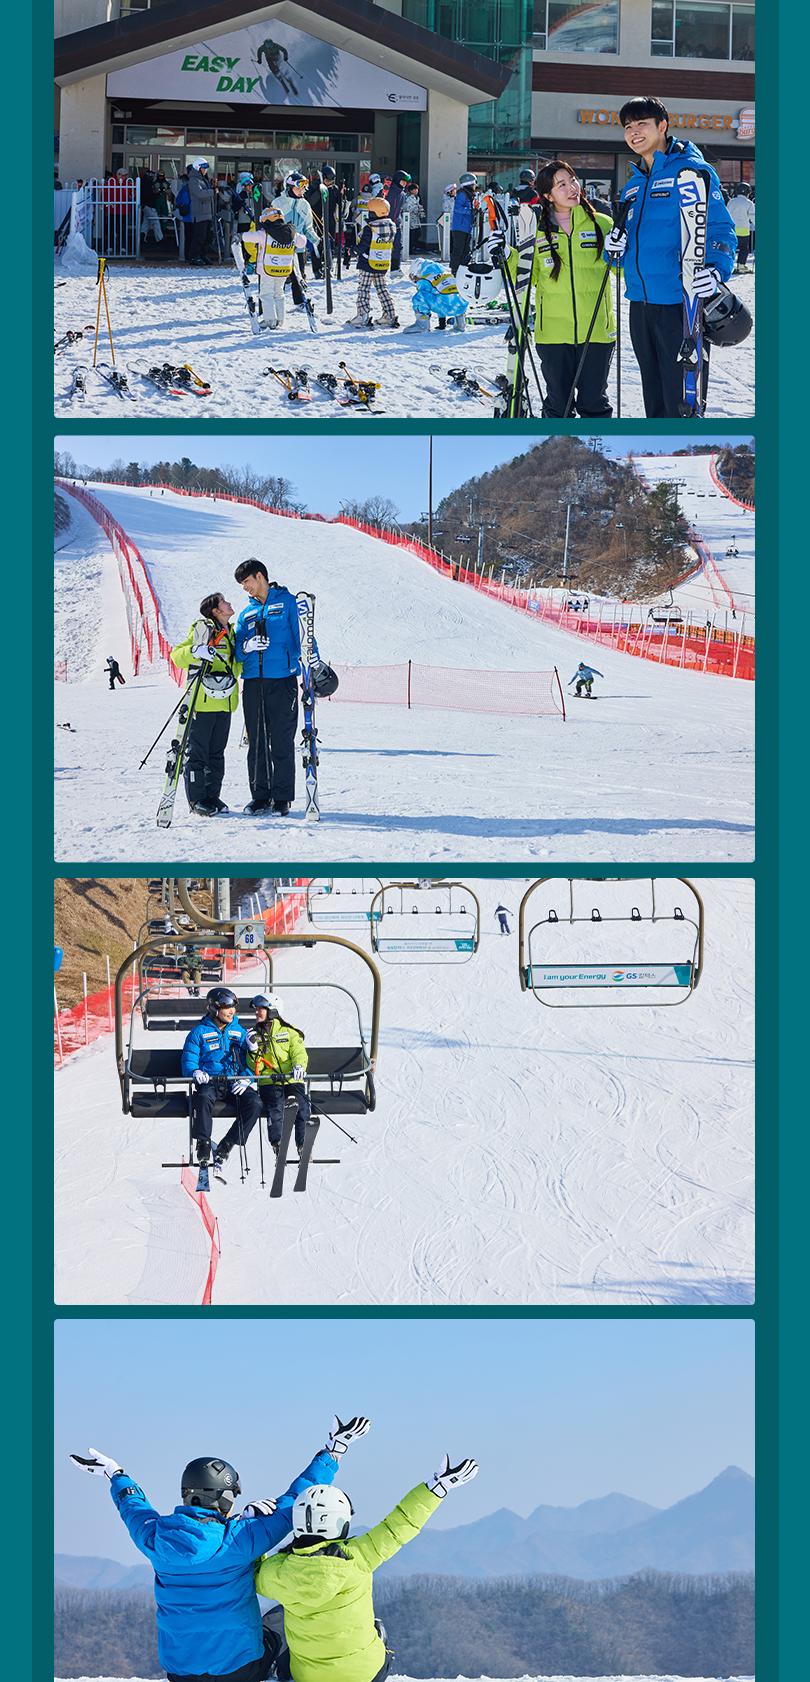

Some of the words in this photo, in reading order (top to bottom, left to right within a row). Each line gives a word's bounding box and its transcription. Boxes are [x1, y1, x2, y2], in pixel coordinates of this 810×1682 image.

[181, 55, 240, 72] EASY
[216, 75, 260, 93] DAY
[578, 109, 622, 125] WON
[669, 113, 733, 130] BURGER
[694, 202, 706, 275] alomon
[245, 934, 254, 944] 68
[578, 973, 606, 981] Energy
